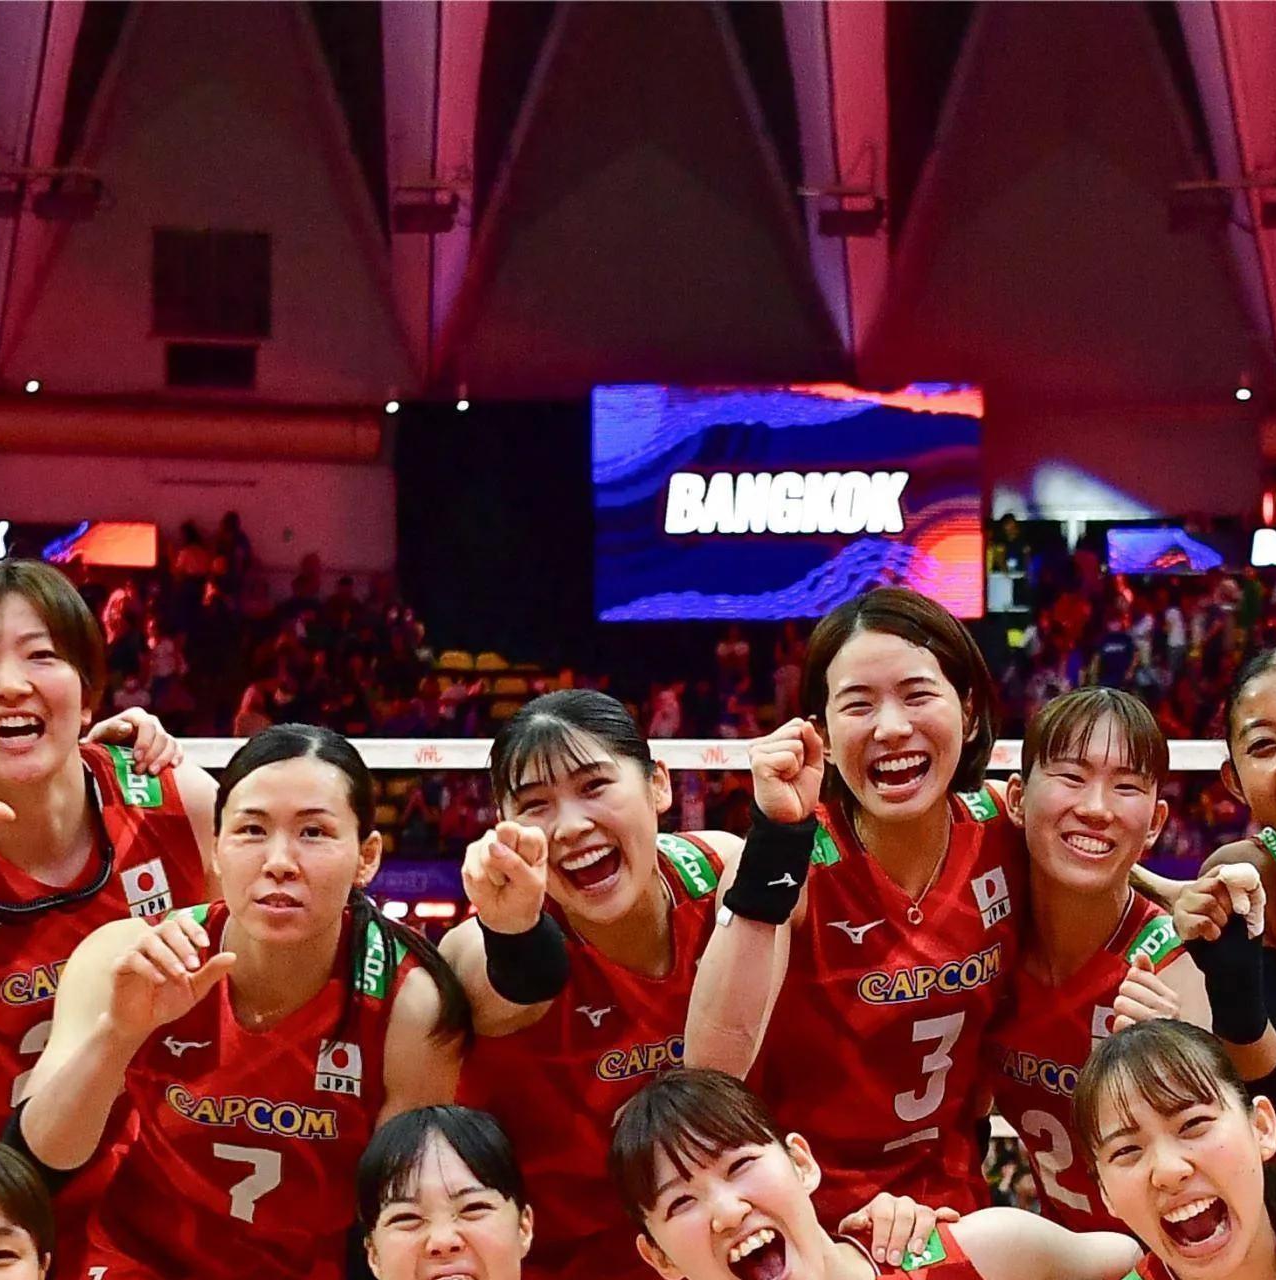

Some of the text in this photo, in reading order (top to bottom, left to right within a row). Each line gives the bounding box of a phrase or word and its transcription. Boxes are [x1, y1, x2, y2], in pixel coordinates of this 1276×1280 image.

[665, 472, 909, 534] BANGKOK
[138, 897, 166, 917] JPN
[988, 901, 1007, 925] JPN
[858, 944, 1002, 1004] CAPCOM
[597, 1036, 685, 1081] CAPC
[894, 1011, 965, 1122] 3
[1004, 1053, 1079, 1097] APCO
[322, 1077, 354, 1093] JPN
[166, 1084, 339, 1139] CAPCOM
[213, 1142, 282, 1224] 7
